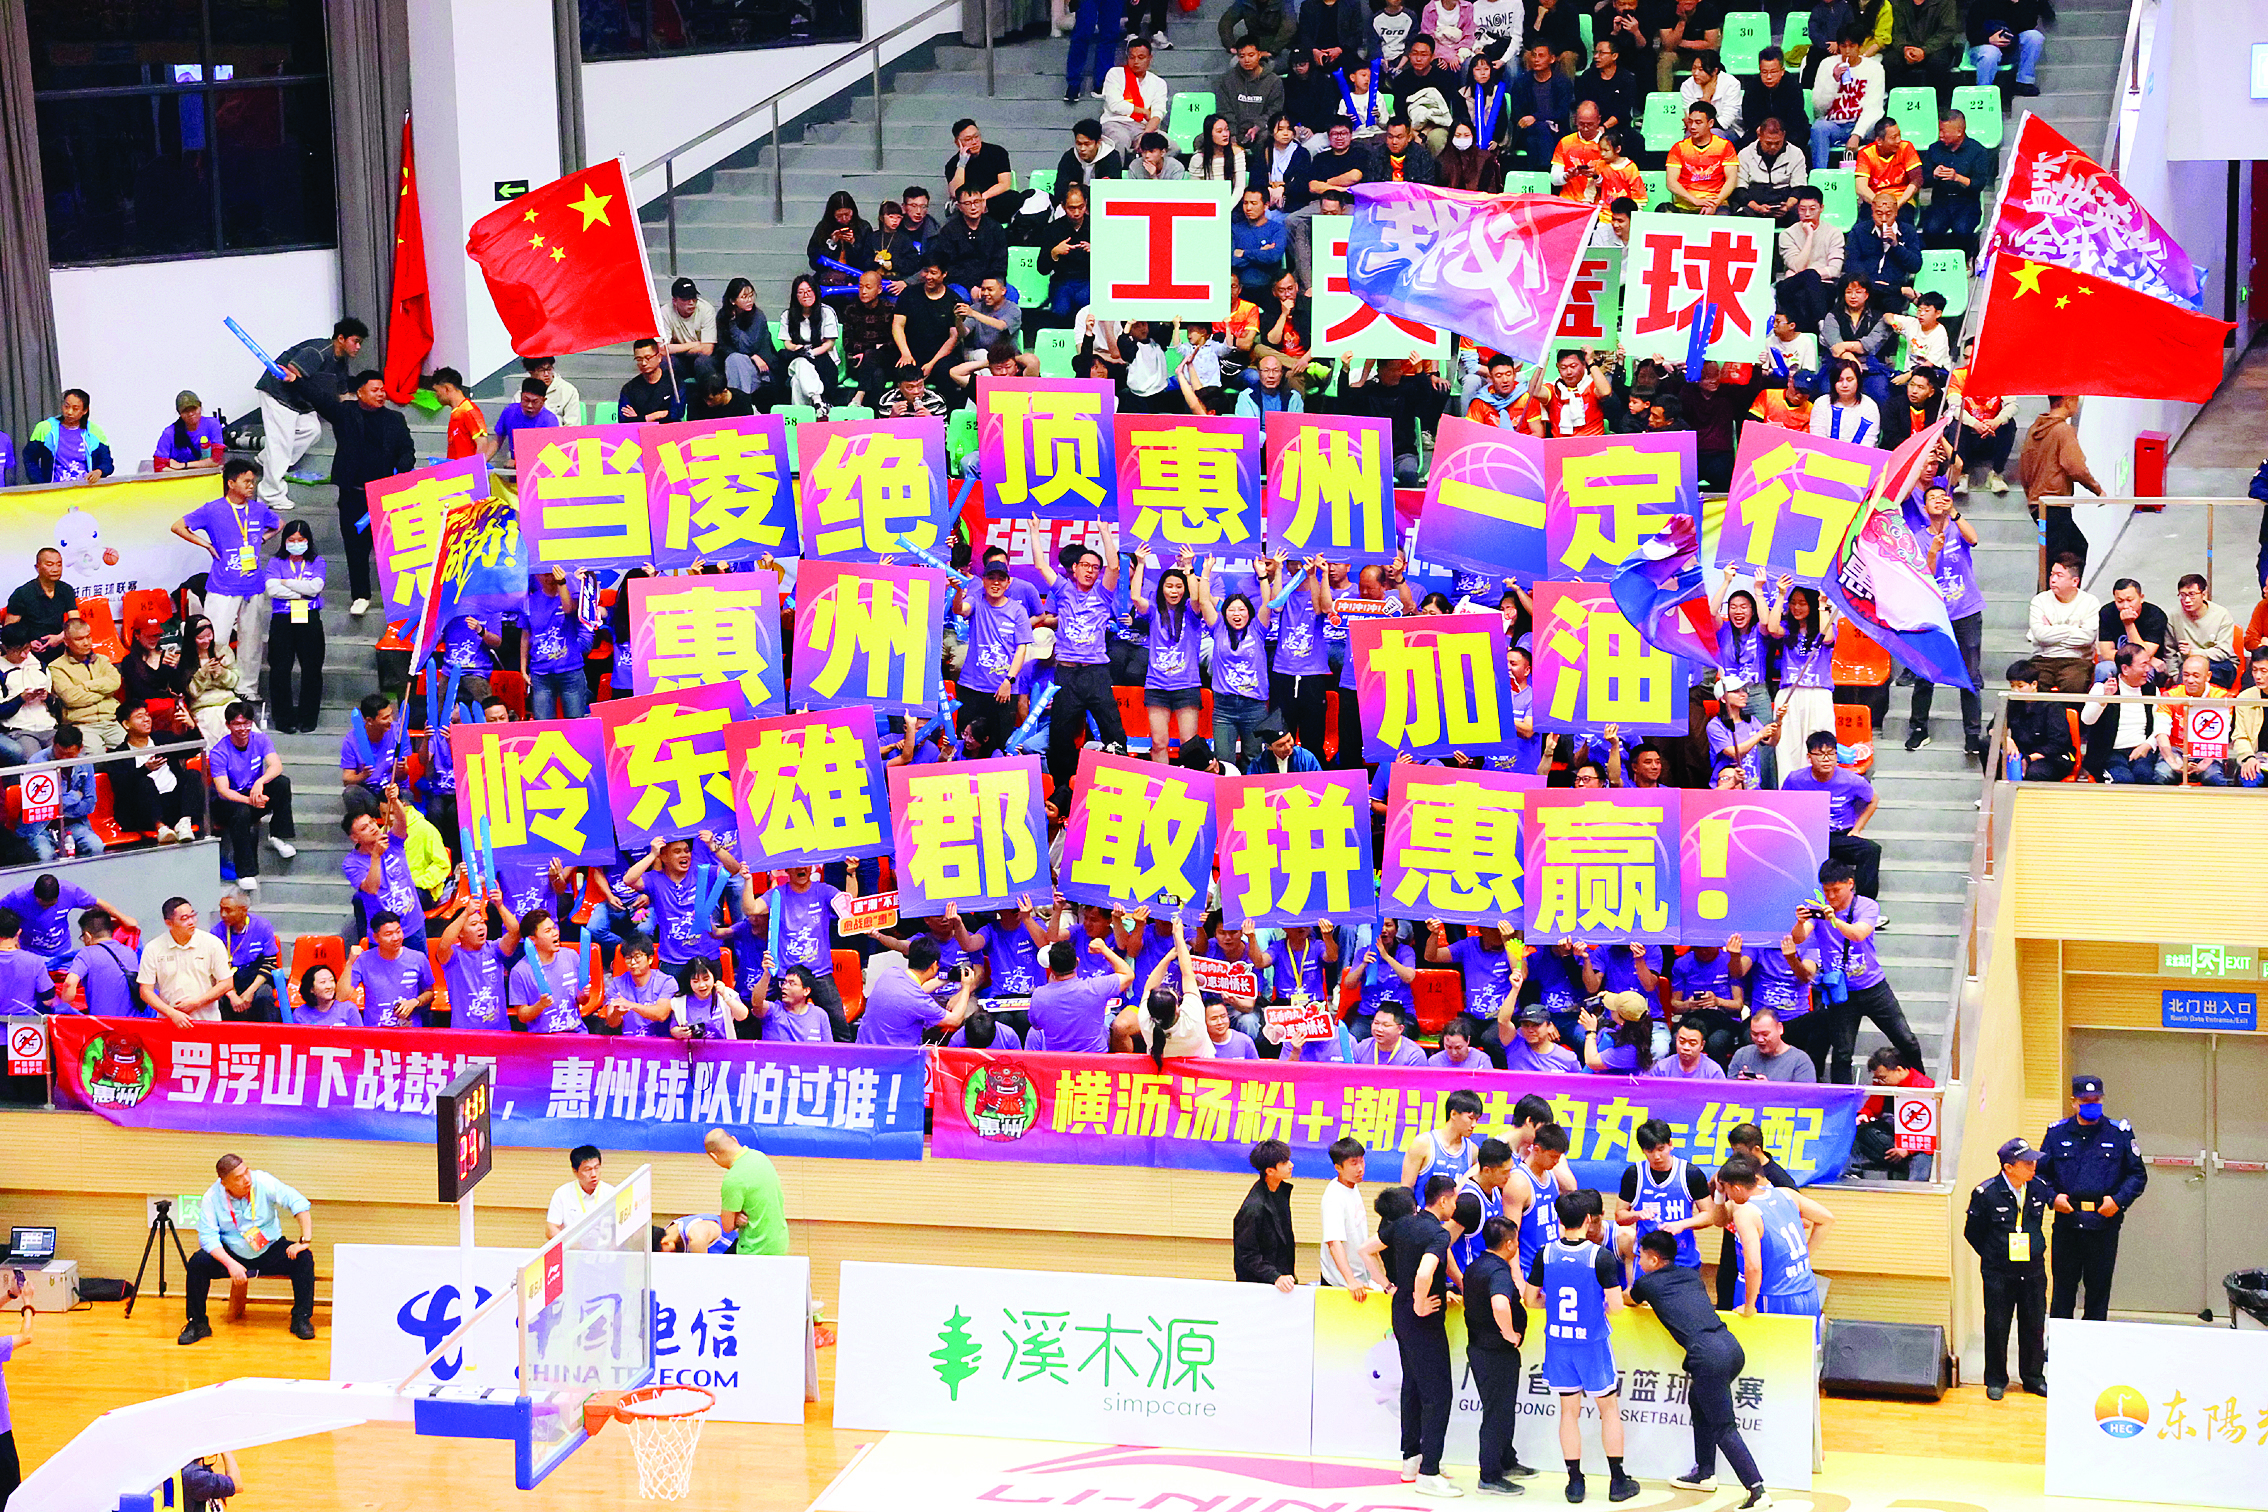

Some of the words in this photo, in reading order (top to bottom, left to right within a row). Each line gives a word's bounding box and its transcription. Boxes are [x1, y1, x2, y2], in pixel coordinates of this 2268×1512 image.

[1739, 27, 1754, 38] 30
[1187, 102, 1201, 113] 48
[1662, 104, 1677, 115] 32
[1906, 101, 1921, 112] 24
[1969, 99, 1985, 111] 22
[1520, 185, 1535, 194] 36
[1823, 181, 1838, 192] 26
[1019, 257, 1034, 269] 52
[1106, 201, 1217, 300] 工
[1636, 231, 1758, 346] 球
[1931, 261, 1948, 272] 22
[1051, 338, 1066, 349] 50
[537, 438, 652, 561] 当
[657, 428, 787, 556] 凌
[814, 431, 931, 556] 绝
[988, 390, 1109, 508] 顶
[1132, 425, 1249, 547] 惠
[1282, 425, 1384, 553] 州
[1437, 476, 1547, 530] 一
[1560, 444, 1682, 573] 定
[1739, 441, 1872, 578] 行
[645, 586, 772, 708] 惠
[809, 574, 925, 705] 州
[1368, 629, 1503, 750] 加
[1547, 594, 1672, 724] 油
[614, 703, 737, 830] 东
[1837, 716, 1852, 728] 32
[466, 730, 593, 856] 岭
[745, 723, 881, 857] 雄
[907, 769, 1038, 901] 郡
[1072, 765, 1209, 904] 敢
[1232, 784, 1361, 916] 拼
[1394, 780, 1525, 914] 惠
[1533, 800, 1668, 934] 赢
[1698, 818, 1732, 920] !
[2168, 998, 2252, 1015] 北门出入口
[2225, 956, 2253, 970] EXIT
[1779, 1221, 1807, 1261] 11
[1002, 1308, 1219, 1393] 溪木源
[1558, 1286, 1578, 1322] 2
[1103, 1394, 1217, 1418] simpcare
[2110, 1423, 2133, 1434] HEC
